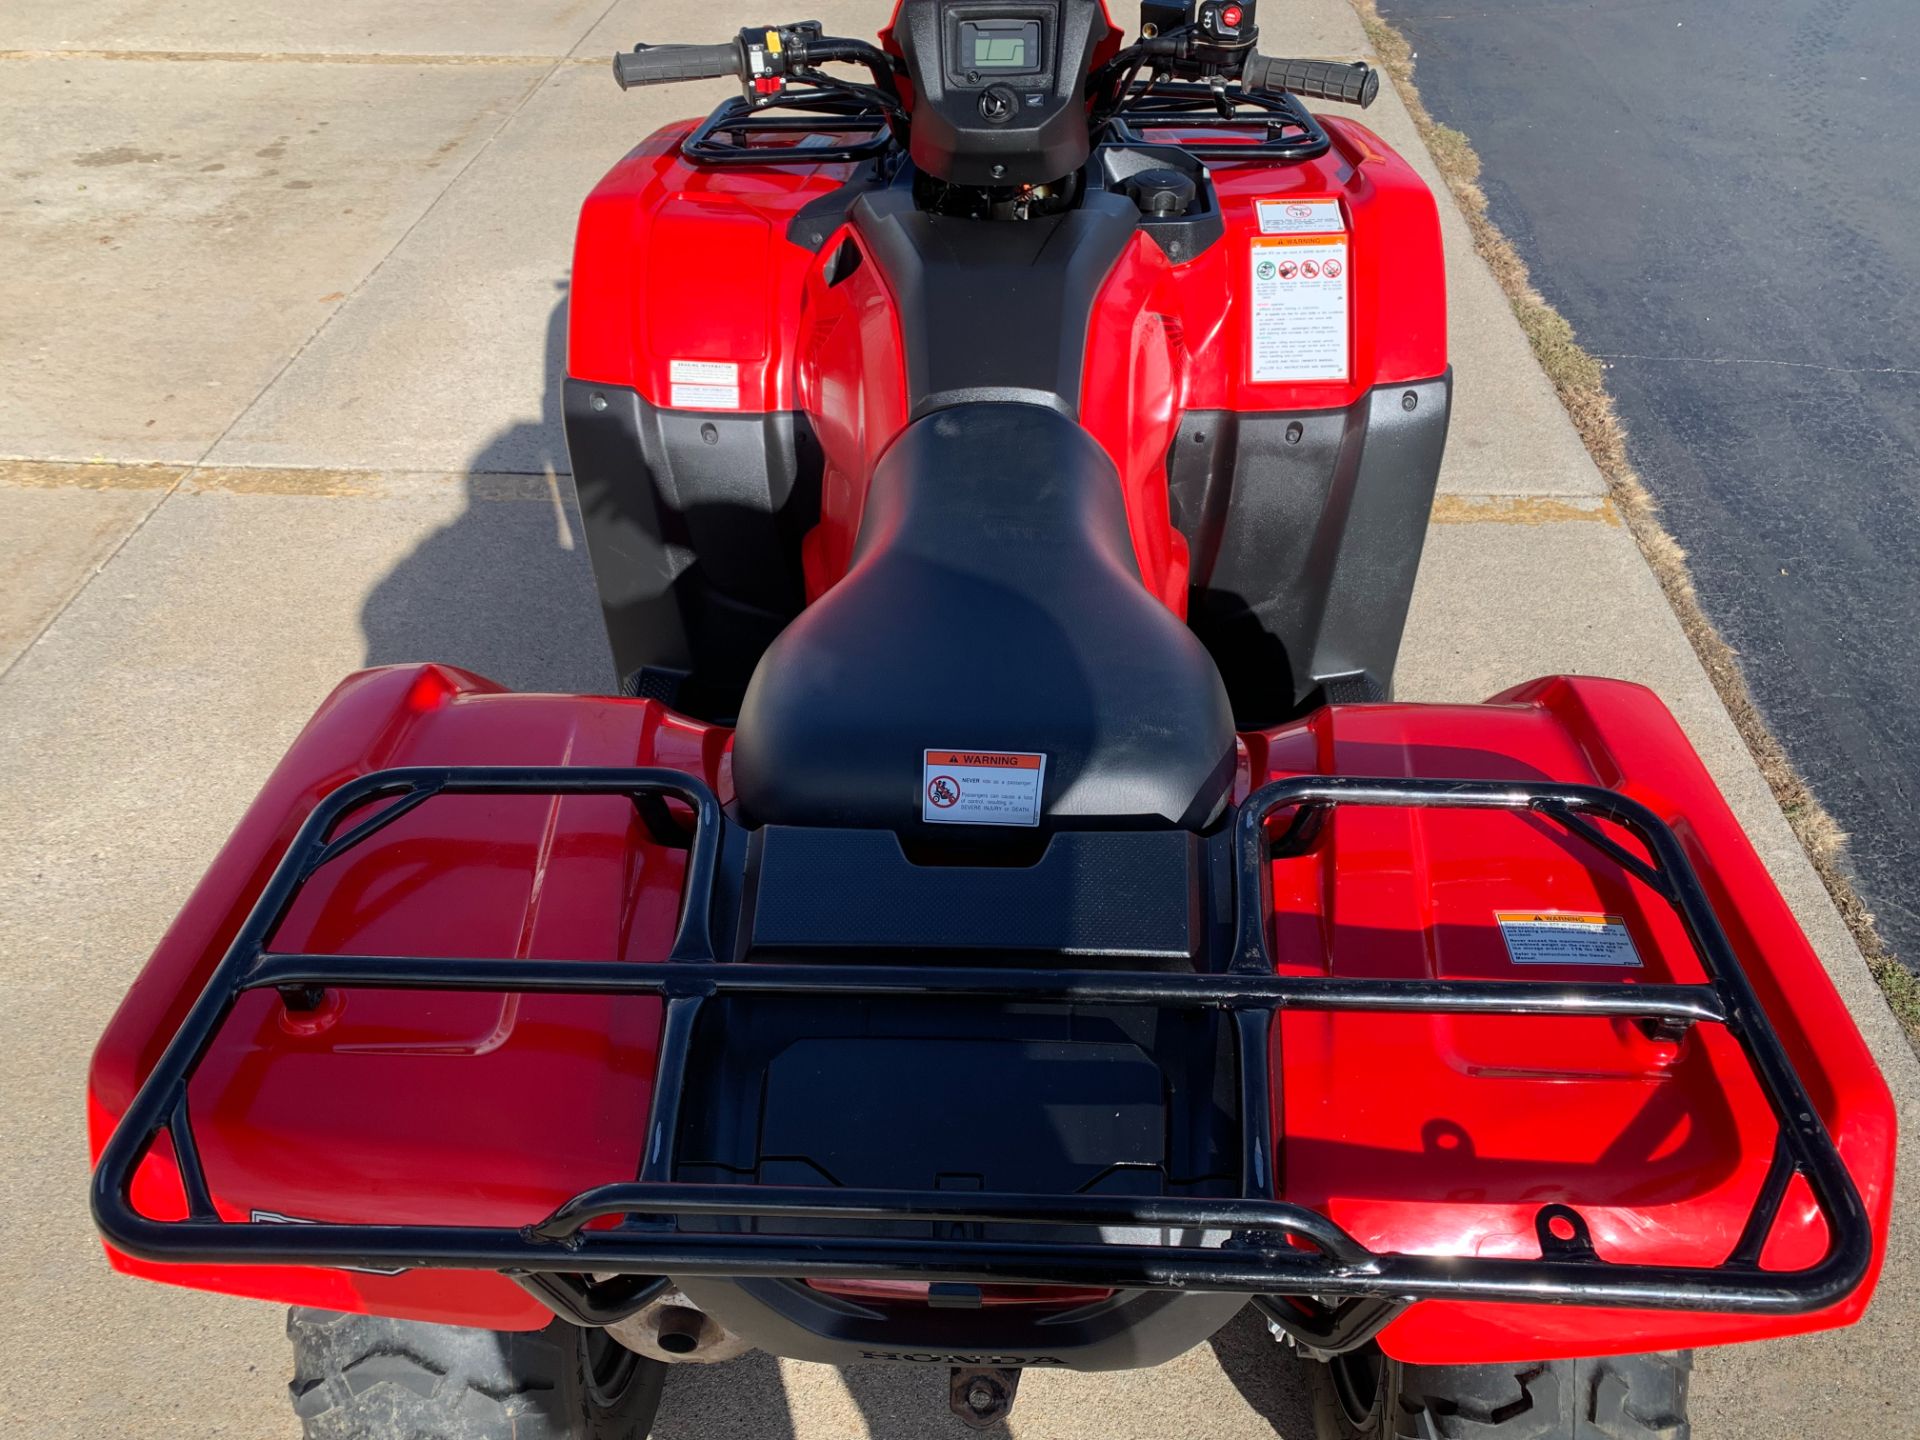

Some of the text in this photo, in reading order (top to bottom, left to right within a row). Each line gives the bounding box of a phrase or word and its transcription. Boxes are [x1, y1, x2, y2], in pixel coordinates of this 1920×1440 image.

[963, 755, 1018, 766] WARNING
[1545, 914, 1585, 922] WARNING
[858, 1349, 1069, 1365] HONDA
